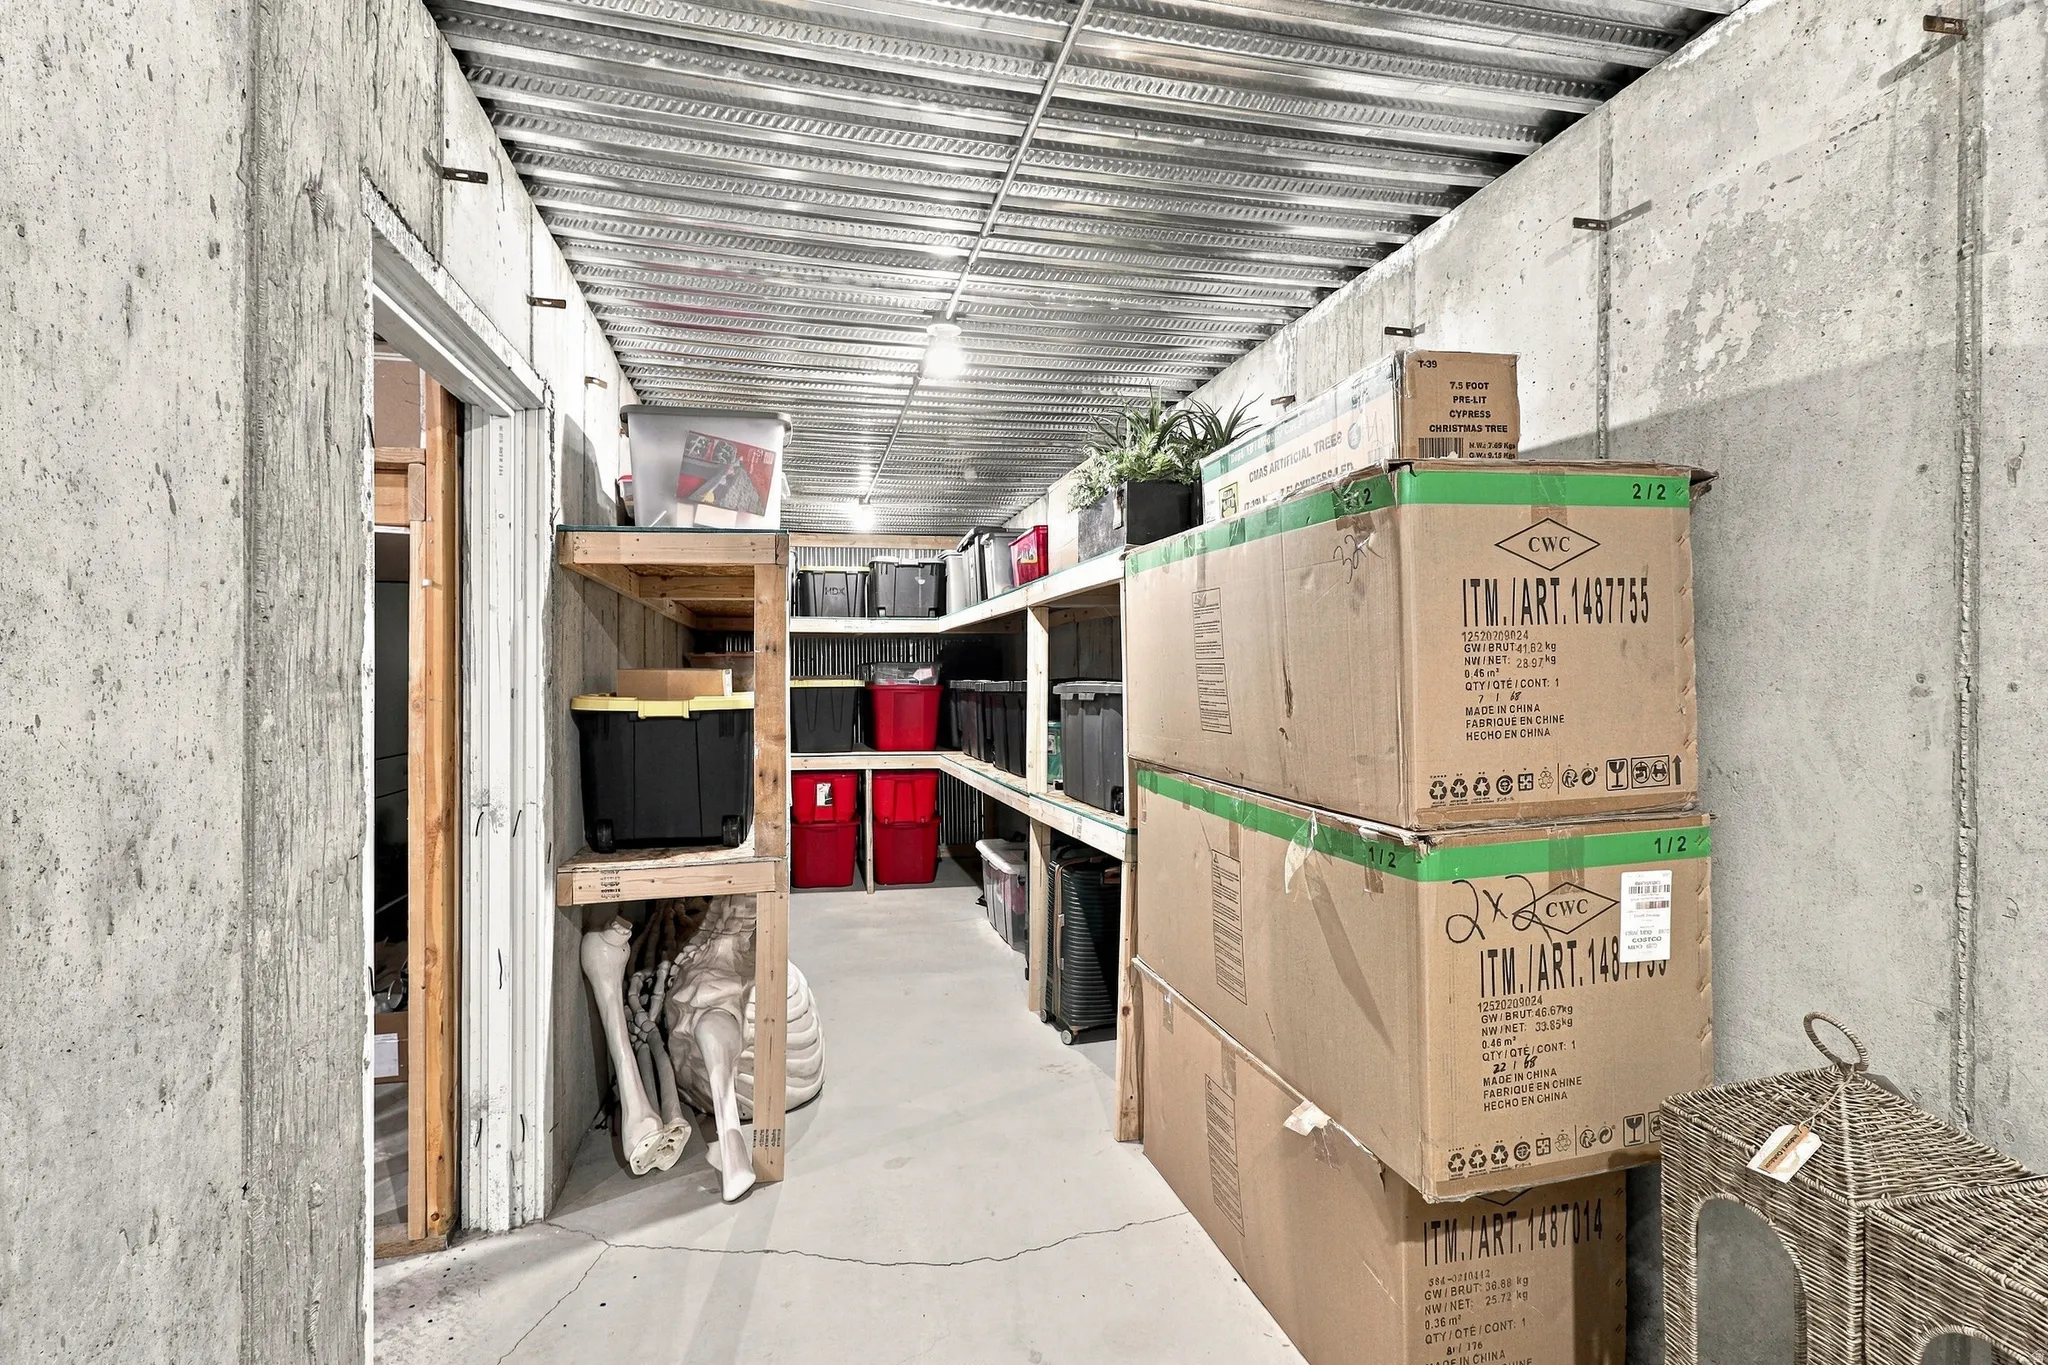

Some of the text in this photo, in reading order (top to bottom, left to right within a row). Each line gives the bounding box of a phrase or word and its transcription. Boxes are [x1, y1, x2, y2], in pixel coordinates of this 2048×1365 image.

[1418, 360, 1437, 368] T-39
[1450, 382, 1489, 390] 7.5 FOOT
[1453, 396, 1487, 404] PRE-LIT
[1450, 410, 1491, 418] CYPRESS
[1429, 424, 1508, 432] CHRISTMAS TREE
[1503, 442, 1516, 450] Kgs
[1249, 465, 1268, 483] CMAS
[1270, 448, 1312, 474] ARTIFICIAL
[1528, 536, 1570, 553] CWC
[825, 586, 846, 596] HDX
[1462, 577, 1649, 627] ITM./ART.1487755
[1462, 630, 1529, 642] 12520209024
[1545, 642, 1556, 652] kg
[1545, 654, 1556, 664] kg
[1464, 669, 1484, 678] 0.46
[1466, 704, 1540, 716] MADE IN CHINA
[1466, 715, 1564, 728] FABRIQUÉ EN CHINE
[1466, 728, 1550, 740] HECHO EN CHINA
[1546, 899, 1588, 918] CWC
[1478, 995, 1542, 1013] 12520209024
[1482, 1038, 1502, 1049] 0.46
[1483, 1068, 1557, 1086] MADE IN CHINA
[1484, 1076, 1582, 1099] FABRIQUÉ EN CHINE
[1484, 1092, 1568, 1112] HECHO EN CHINA
[1423, 1198, 1602, 1266] ITM./ART.1487014
[1516, 1276, 1528, 1286] kg
[1516, 1290, 1528, 1300] kg
[1425, 1317, 1446, 1330] 0.36
[1460, 1356, 1470, 1365] IN
[1472, 1350, 1506, 1364] CHINA
